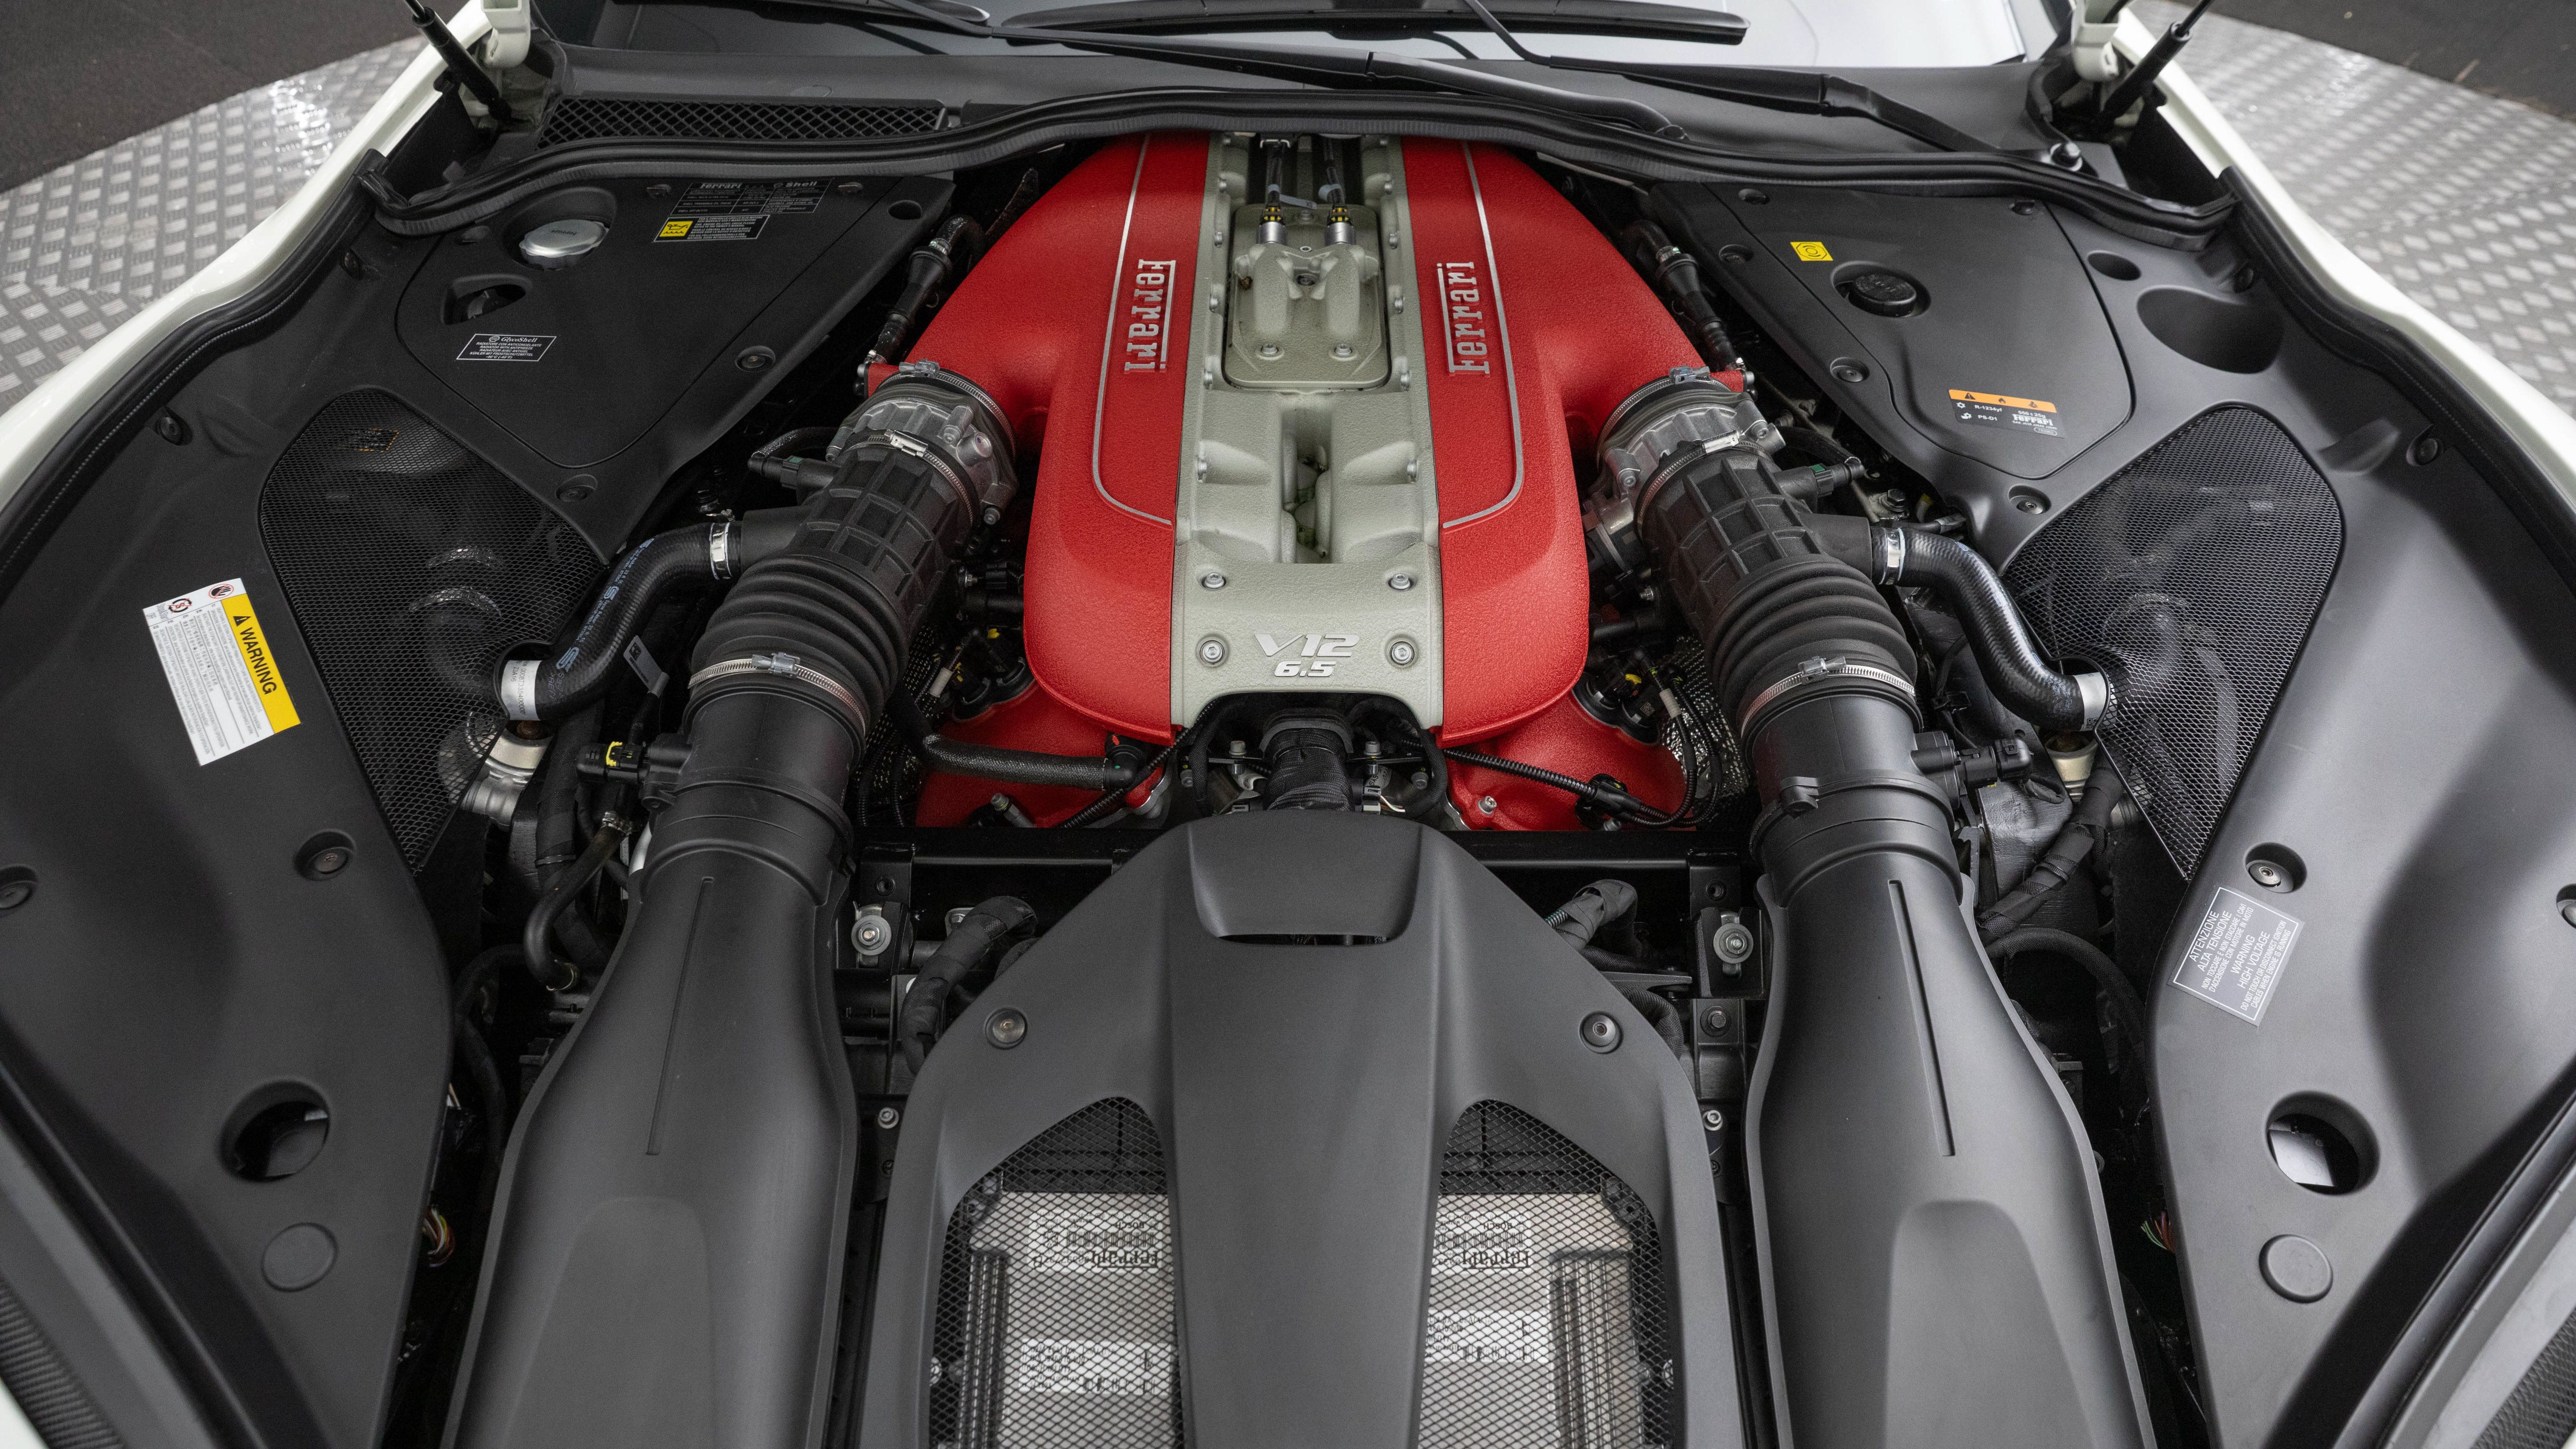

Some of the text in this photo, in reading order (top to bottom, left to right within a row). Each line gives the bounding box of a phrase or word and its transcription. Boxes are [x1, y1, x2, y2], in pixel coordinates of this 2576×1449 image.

[1123, 259, 1176, 372] Ferrari
[1437, 262, 1490, 375] Ferrari
[2012, 414, 2054, 426] Ferrari
[239, 627, 278, 695] WARNING
[510, 666, 519, 682] 23A16
[1254, 633, 1360, 658] V12
[1274, 660, 1337, 678] 6.5
[2188, 910, 2220, 962] ATTENZIONE
[2196, 910, 2232, 972] ALTA TENSIONE
[2201, 976, 2212, 989] NON
[2207, 955, 2222, 977] TOCCARE
[2219, 940, 2229, 952] NON
[2224, 916, 2240, 941] STACCARE
[2237, 903, 2247, 915] CAVI
[2208, 958, 2229, 992] D'ACCENSIONE
[2224, 947, 2235, 959] CON
[2230, 927, 2244, 948] MOTORE
[2242, 907, 2254, 922] MOTO
[2230, 934, 2255, 974] WARNING
[2237, 930, 2270, 988] HIGH VOLTAGE
[2240, 919, 2287, 1011] DO NOT TOUCH OR DISCONNECT IGNITION
[2250, 989, 2264, 1008] CABLES
[2259, 974, 2271, 990] WHEN
[2266, 956, 2279, 974] ENGINE
[2276, 929, 2291, 951] RUNNING
